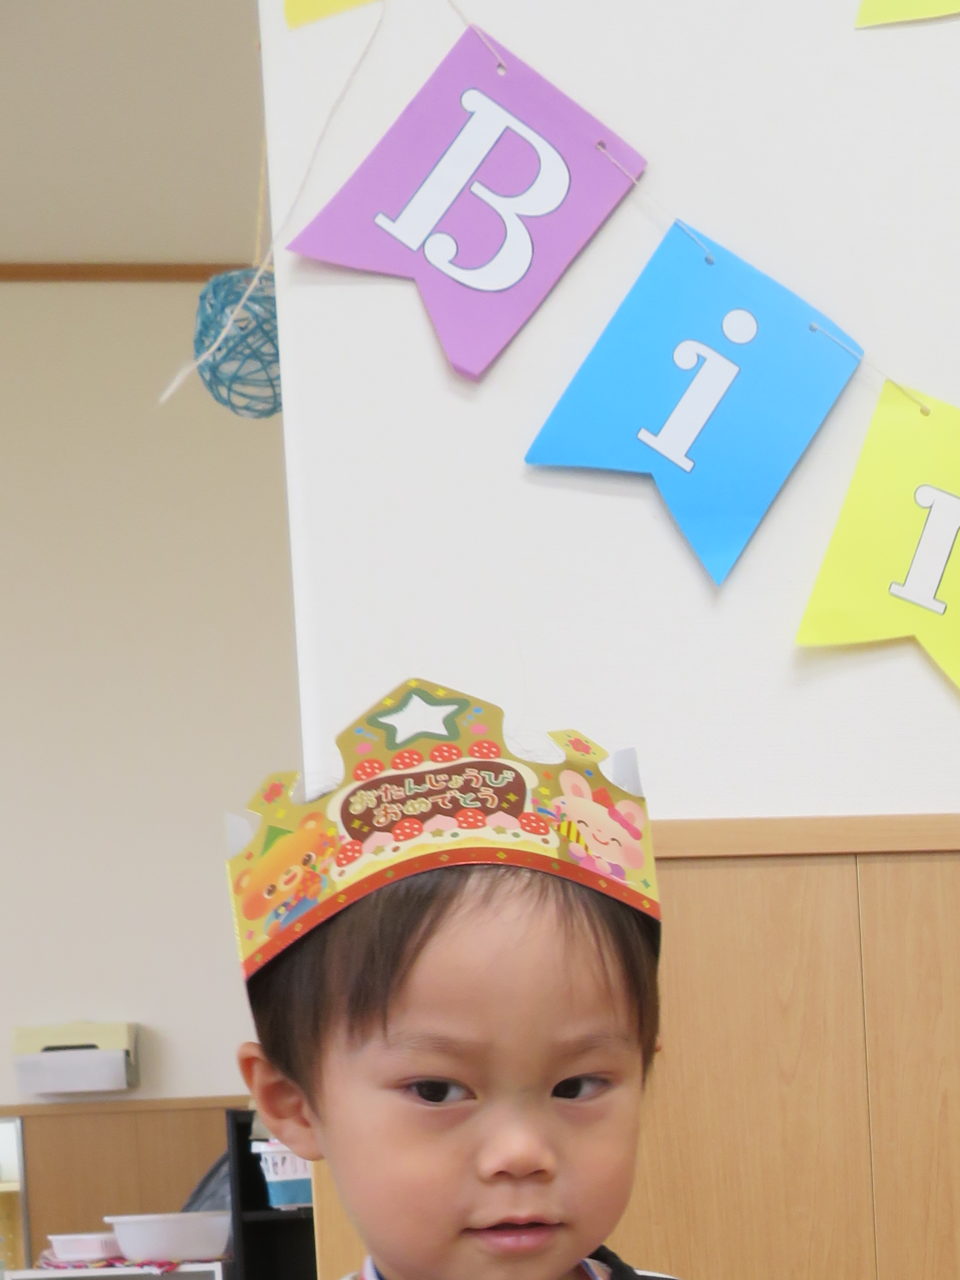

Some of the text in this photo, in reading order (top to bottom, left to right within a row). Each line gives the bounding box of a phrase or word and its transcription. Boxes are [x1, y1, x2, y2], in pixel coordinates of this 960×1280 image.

[349, 768, 515, 815] おたんじょうび
[372, 787, 499, 827] おめでとう
